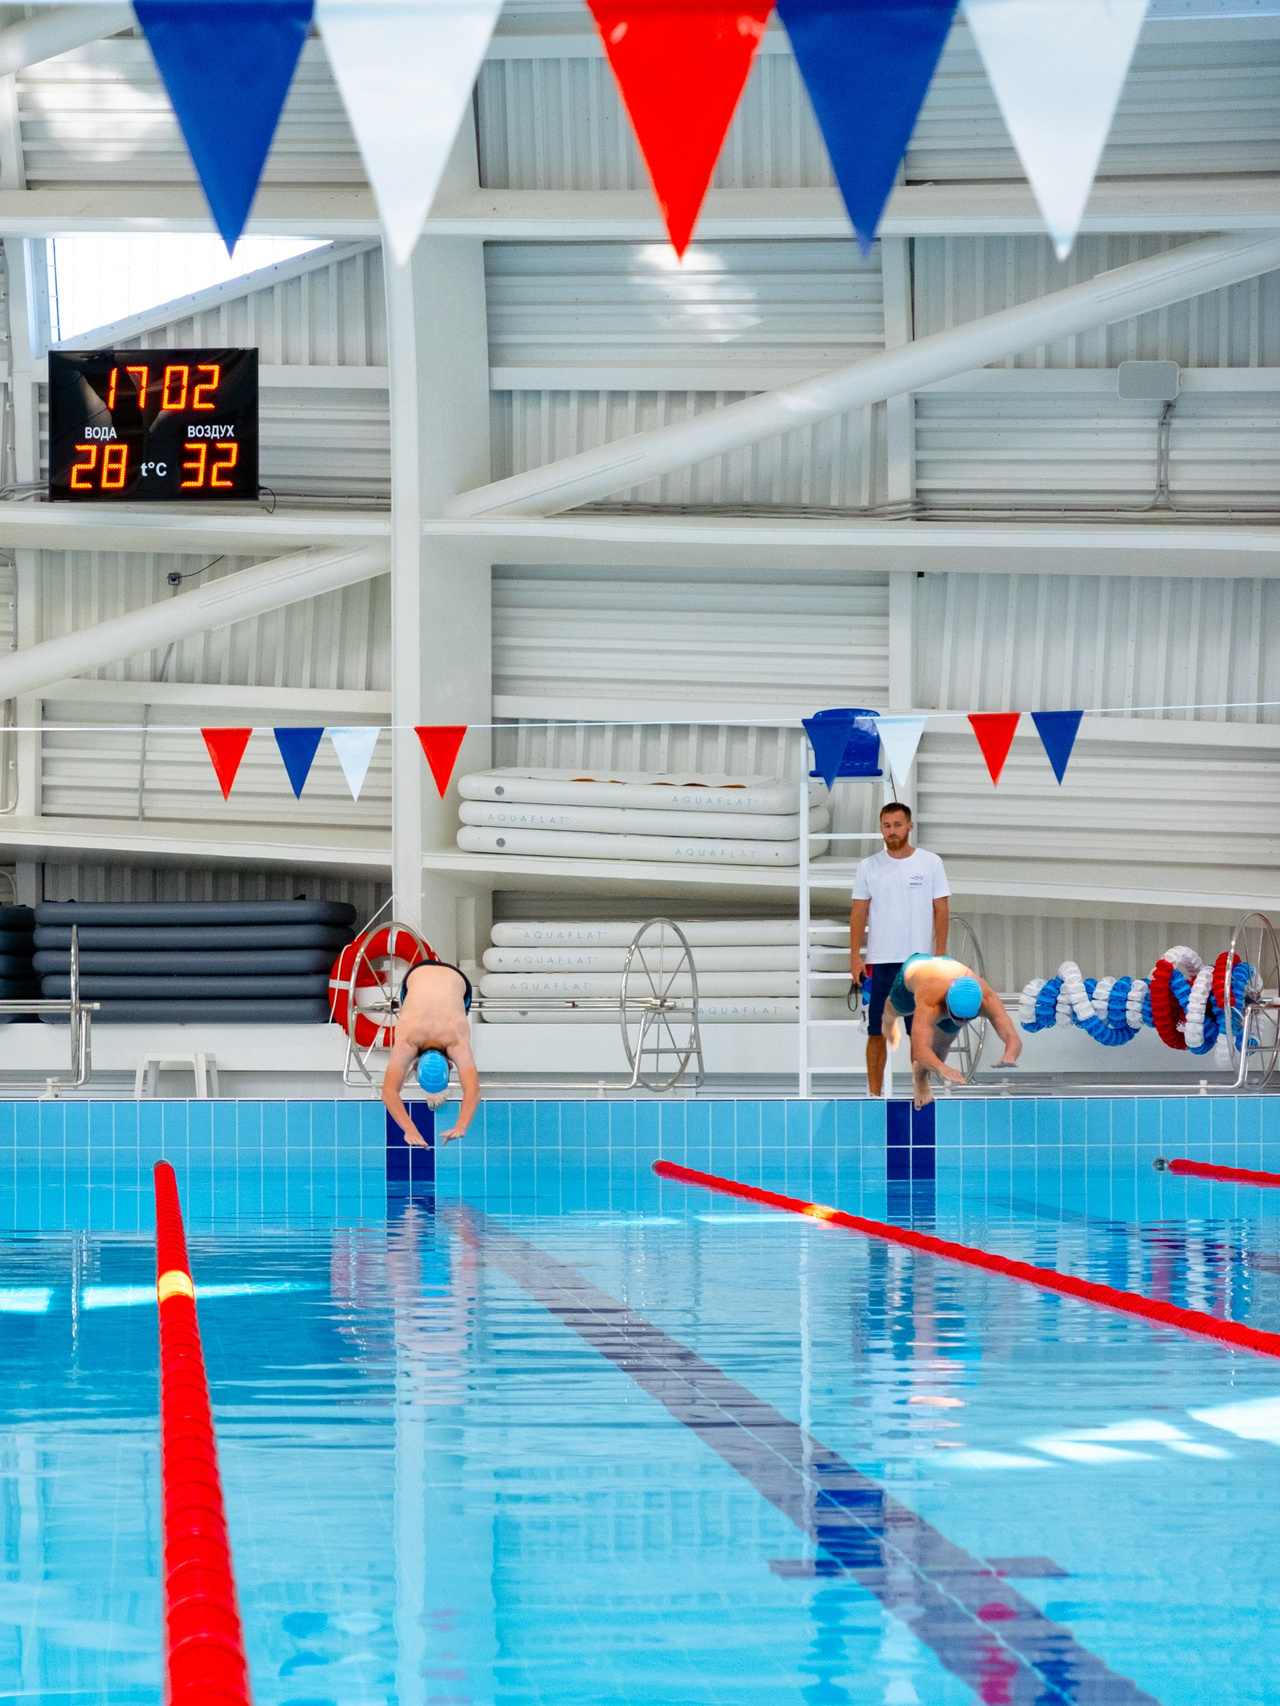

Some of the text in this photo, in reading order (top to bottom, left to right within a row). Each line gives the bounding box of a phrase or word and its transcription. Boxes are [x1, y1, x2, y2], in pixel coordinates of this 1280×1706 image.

[84, 426, 118, 441] ВОДА
[187, 424, 235, 439] ВОЗДУХ
[70, 444, 128, 489] 28
[181, 442, 238, 488] 32
